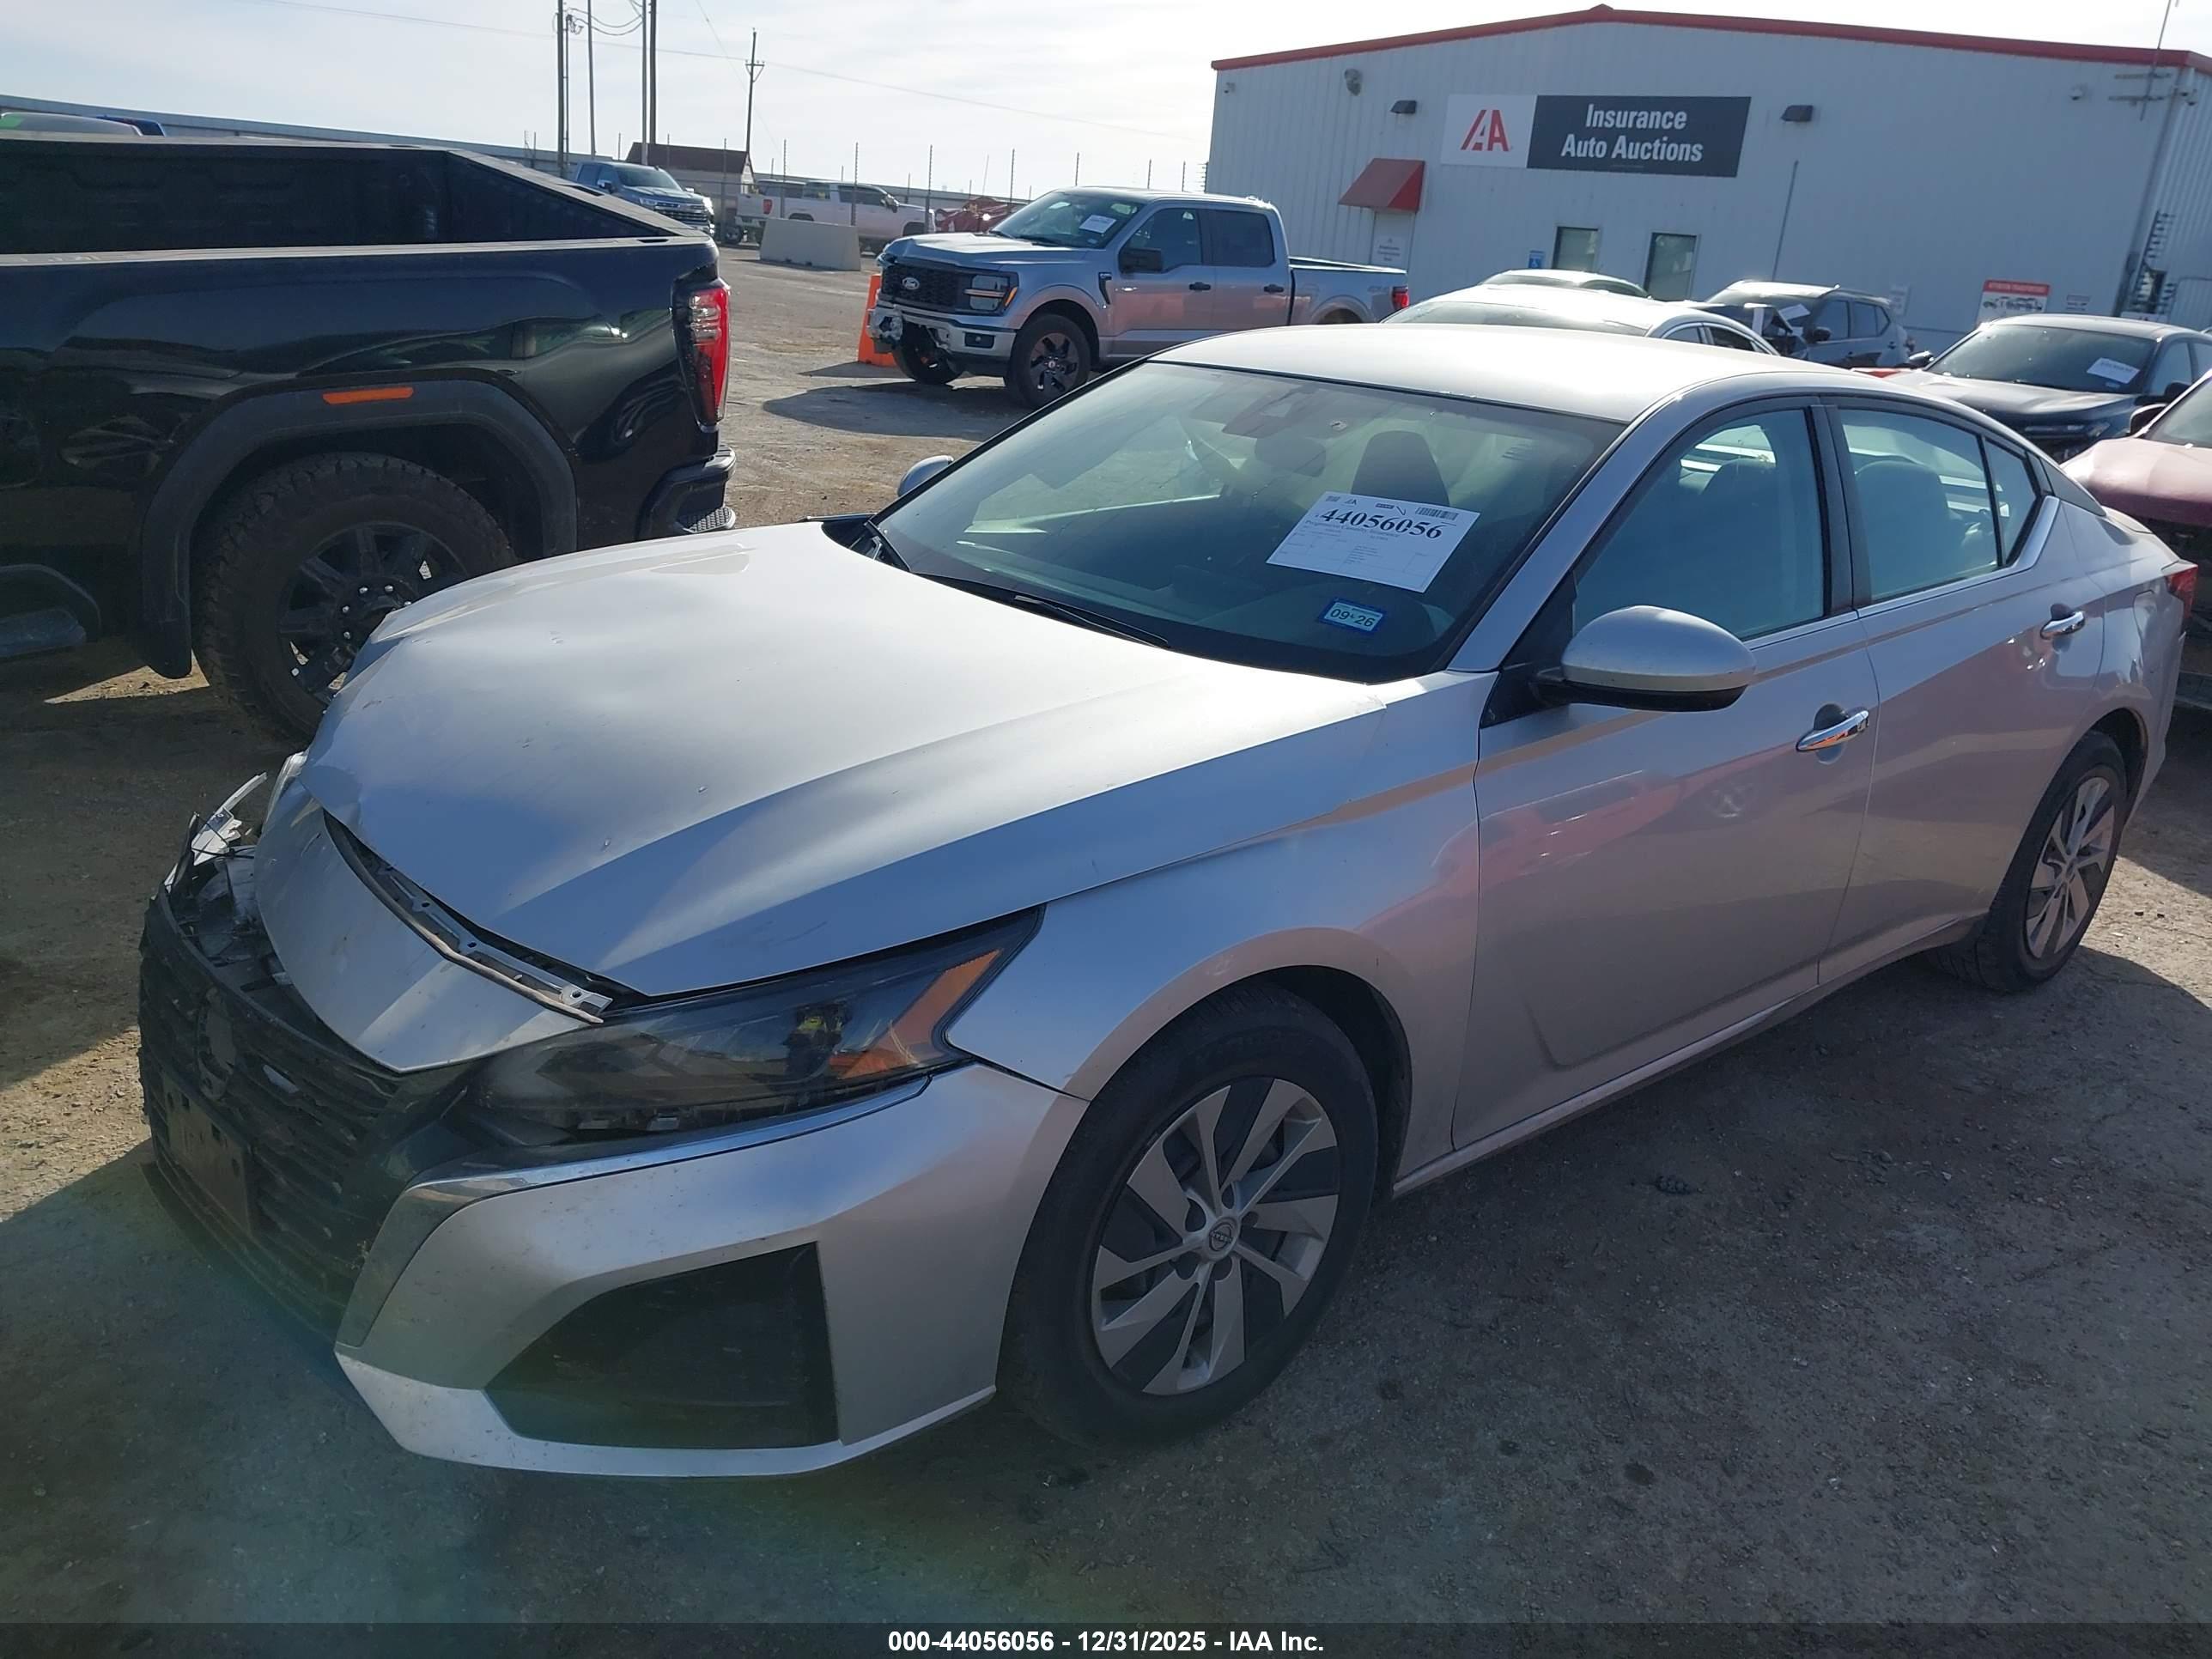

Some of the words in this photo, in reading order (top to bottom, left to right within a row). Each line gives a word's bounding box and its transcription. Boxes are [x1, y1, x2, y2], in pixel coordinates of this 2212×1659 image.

[1585, 103, 1688, 130] Insurance
[1560, 133, 1607, 159] Auto
[1611, 135, 1704, 162] Auctions
[1321, 508, 1447, 539] 44056056
[1354, 615, 1376, 627] 26
